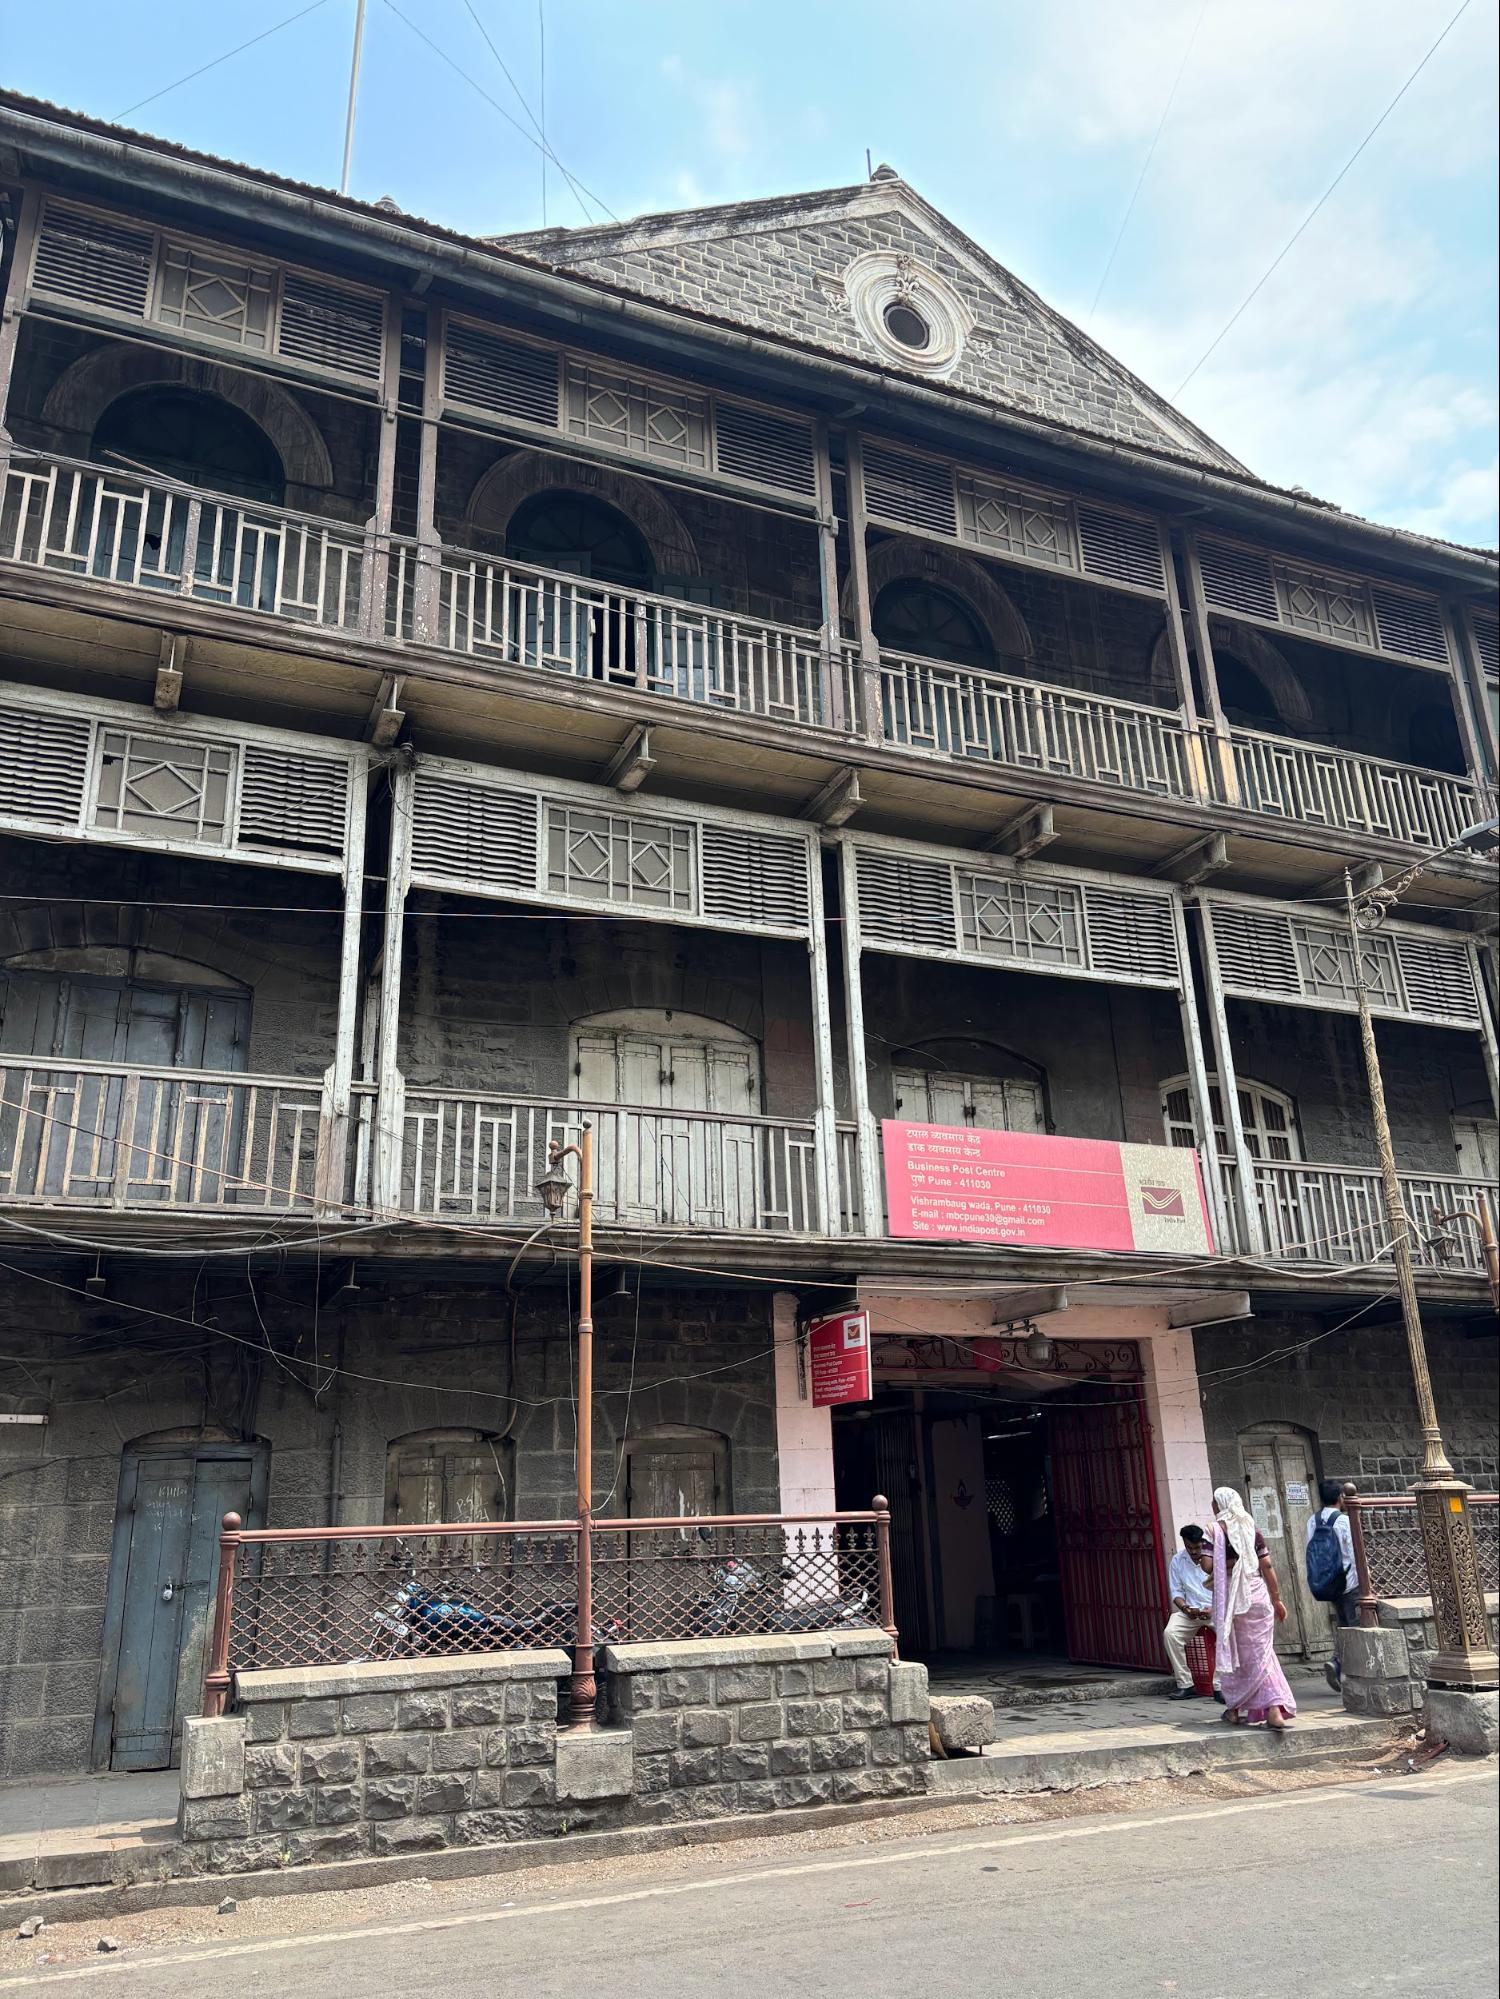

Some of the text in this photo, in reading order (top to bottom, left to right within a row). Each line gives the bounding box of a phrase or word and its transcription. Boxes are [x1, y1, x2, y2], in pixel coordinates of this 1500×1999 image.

[906, 1129, 928, 1138] टपाल
[908, 1161, 1006, 1178] Business Post Centre
[911, 1173, 925, 1187] पुणे
[928, 1175, 952, 1186] Pune
[959, 1179, 991, 1189] 411030
[911, 1196, 967, 1210] Vishrambaug
[995, 1202, 1016, 1212] Pune
[1023, 1205, 1051, 1214] 411030
[911, 1208, 939, 1218] E-mail
[946, 1212, 1045, 1225] mbcpune30@gmail.com
[913, 1221, 929, 1230] Site
[937, 1224, 1025, 1237] www.indiapost.gov.in
